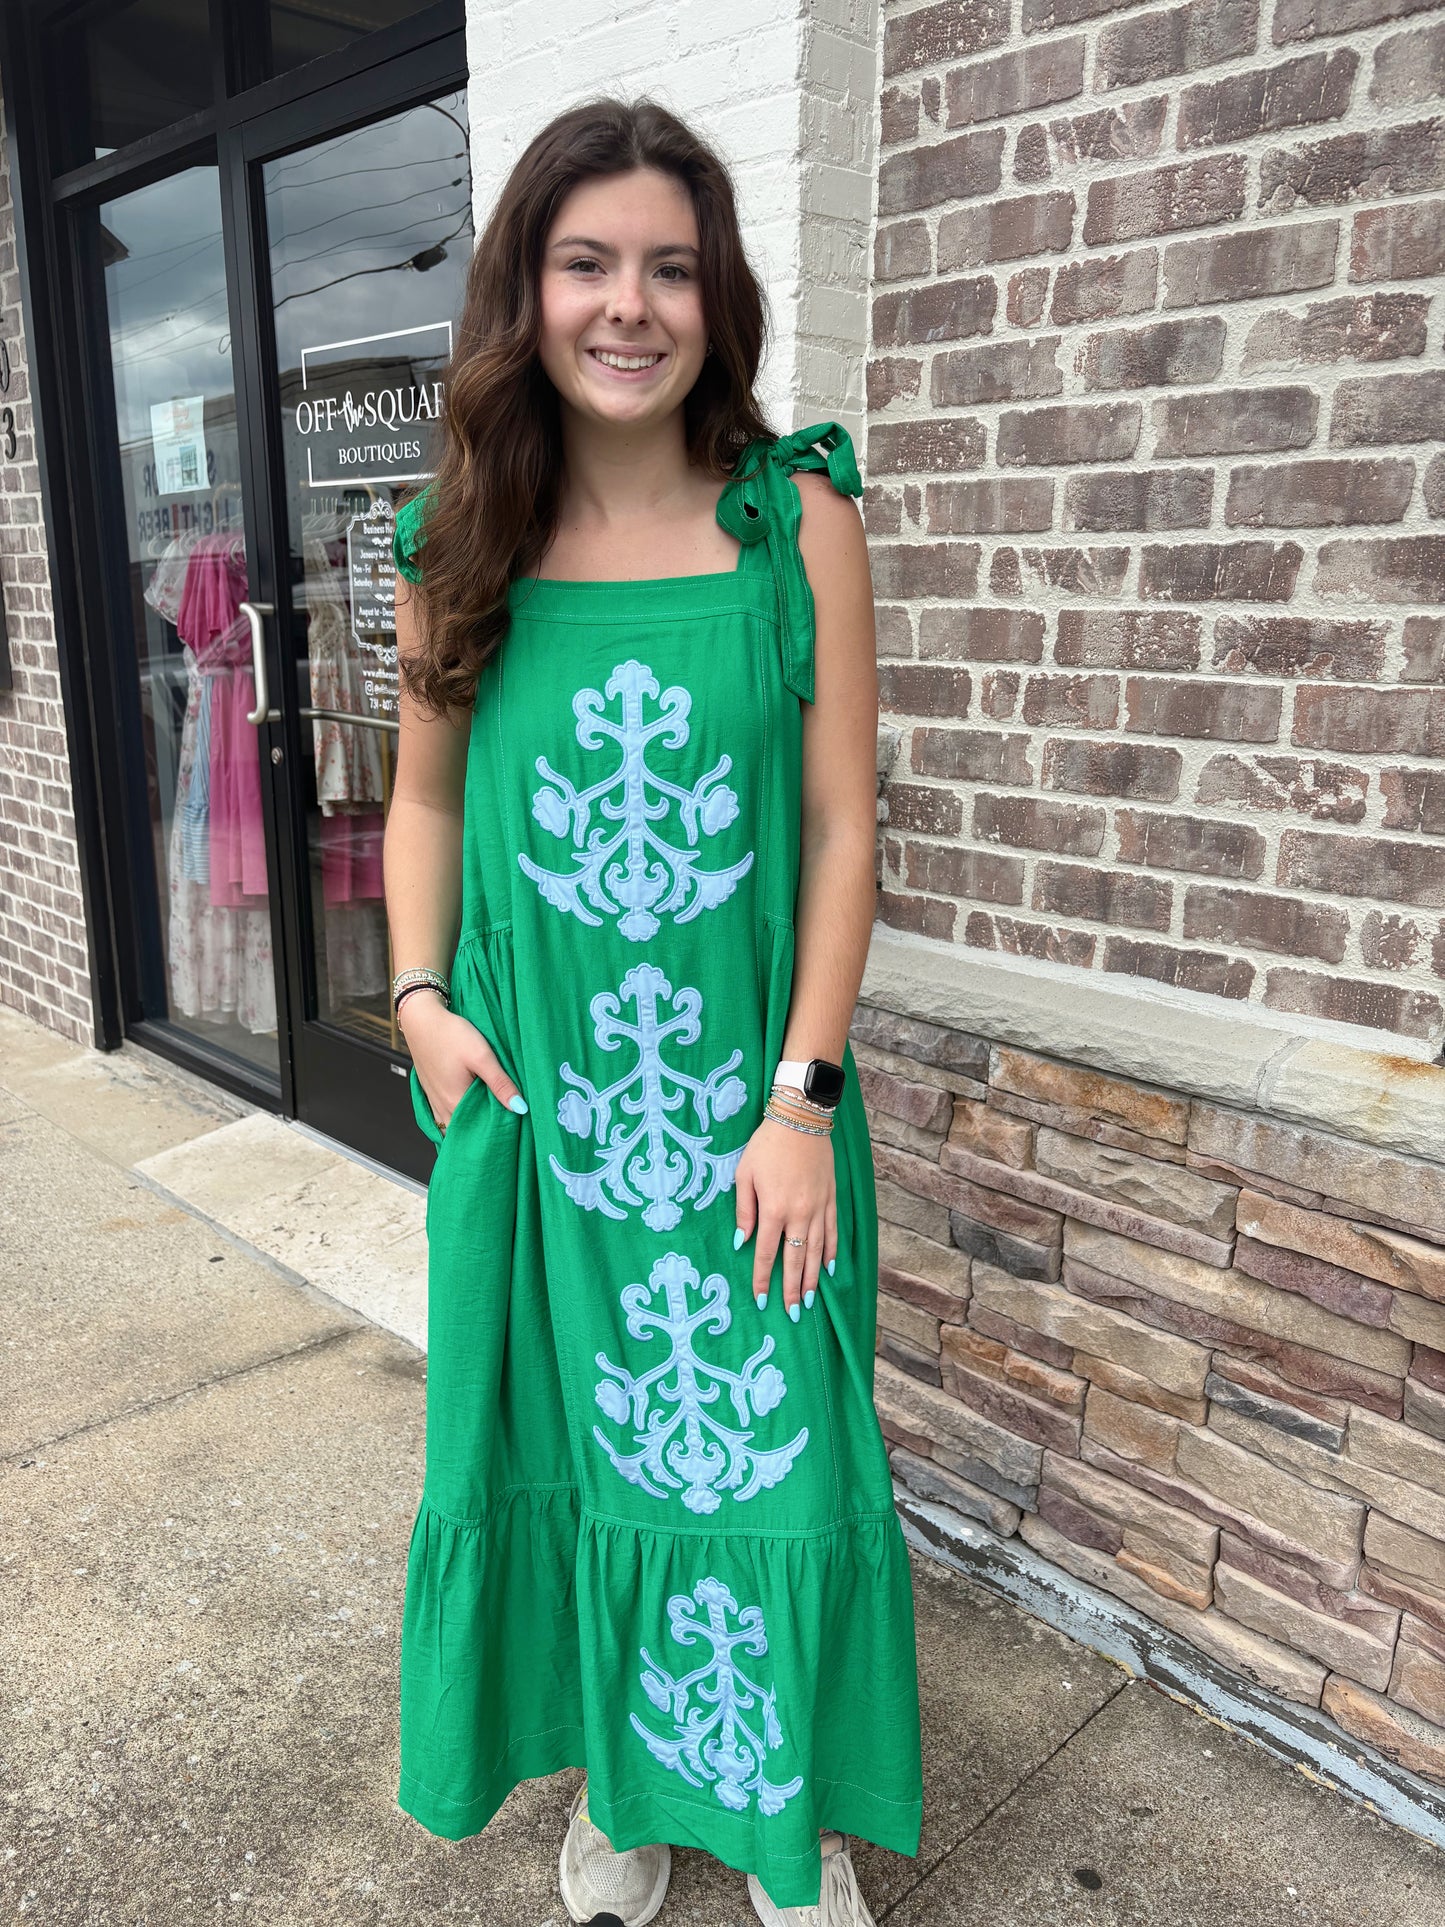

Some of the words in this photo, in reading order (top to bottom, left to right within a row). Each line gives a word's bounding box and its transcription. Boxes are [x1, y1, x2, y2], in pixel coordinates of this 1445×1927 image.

[296, 397, 338, 435] OFF
[338, 440, 421, 465] BOUTIQUES
[363, 522, 385, 535] Business
